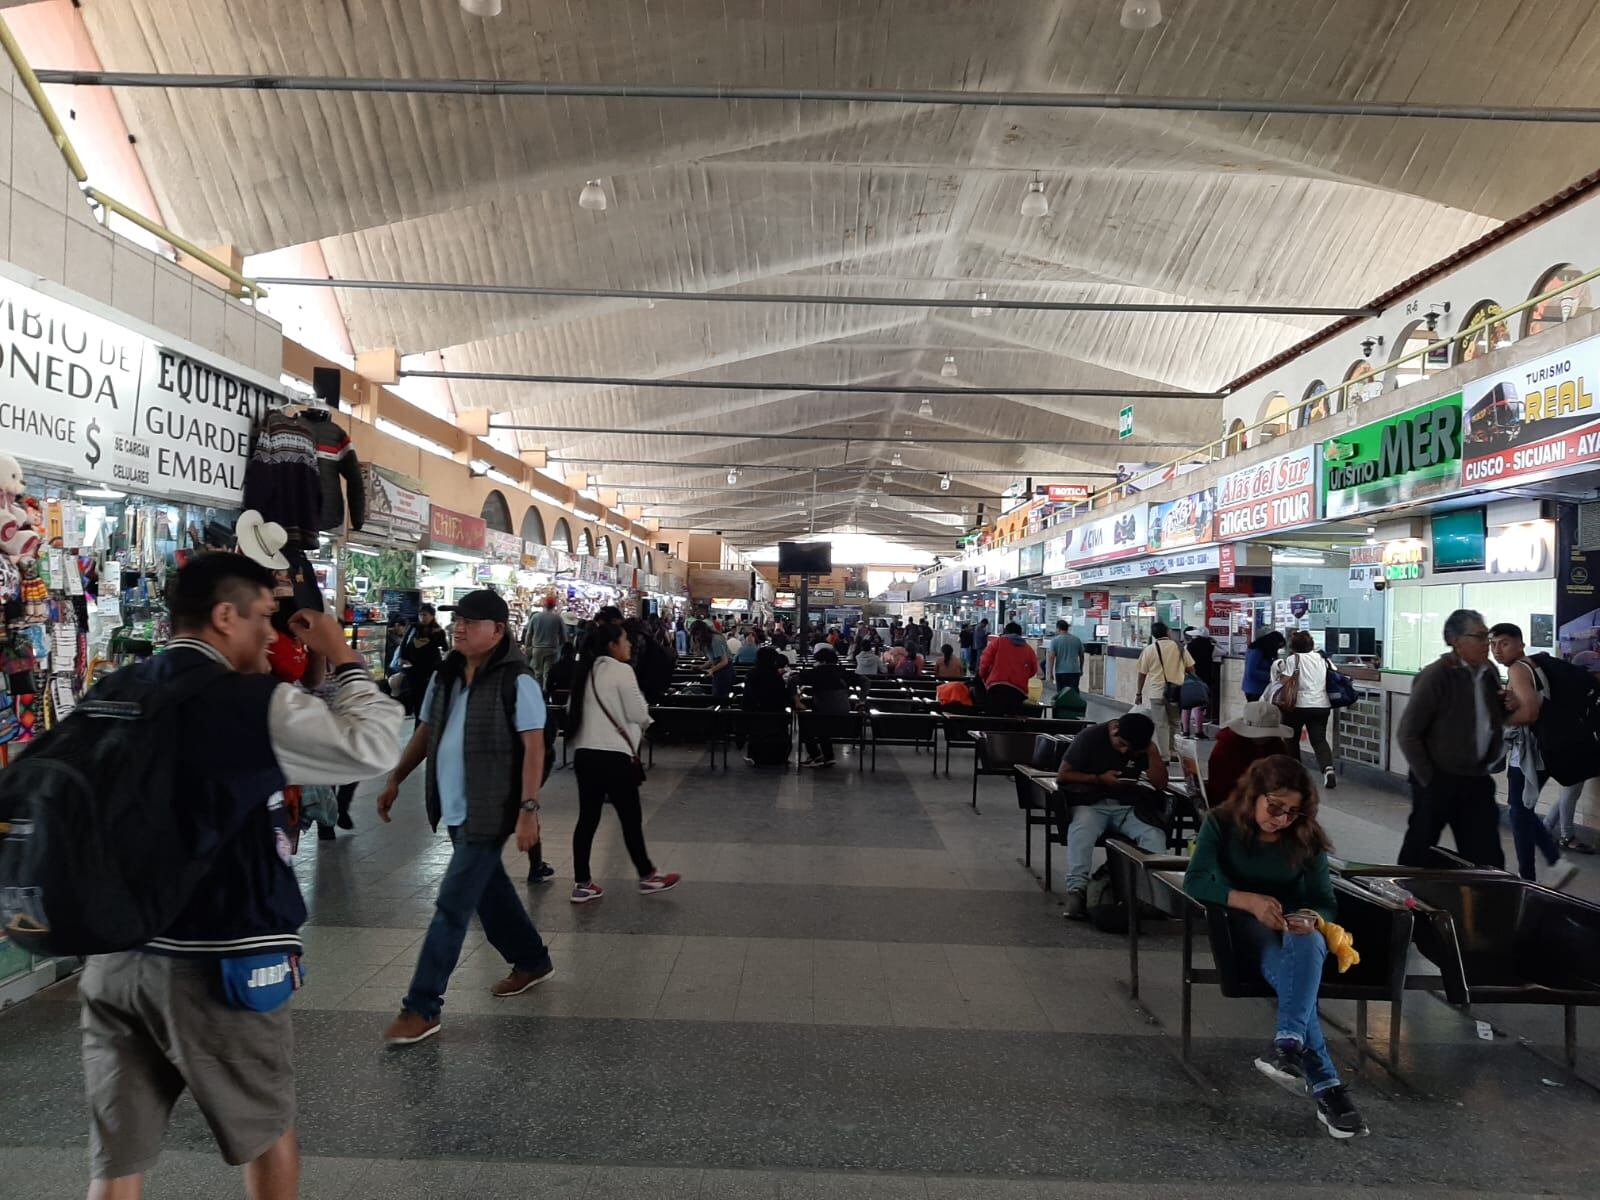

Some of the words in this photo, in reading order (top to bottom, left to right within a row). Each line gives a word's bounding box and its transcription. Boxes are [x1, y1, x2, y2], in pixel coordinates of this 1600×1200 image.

[0, 342, 118, 410] NEDA
[100, 340, 130, 373] DE
[1526, 360, 1571, 385] TURISMO
[1525, 376, 1593, 424] REAL
[114, 437, 123, 451] SE
[145, 406, 249, 458] GUARDE
[1378, 405, 1457, 478] MER
[112, 464, 149, 485] CELULARES
[157, 447, 247, 491] EMBAL
[1466, 456, 1504, 480] CUSCO
[1513, 440, 1566, 470] SICUANI
[1221, 474, 1249, 505] Alas
[1253, 461, 1277, 497] del
[1279, 456, 1310, 490] Sur
[433, 511, 464, 540] CHIFA
[1271, 491, 1310, 525] TOUR
